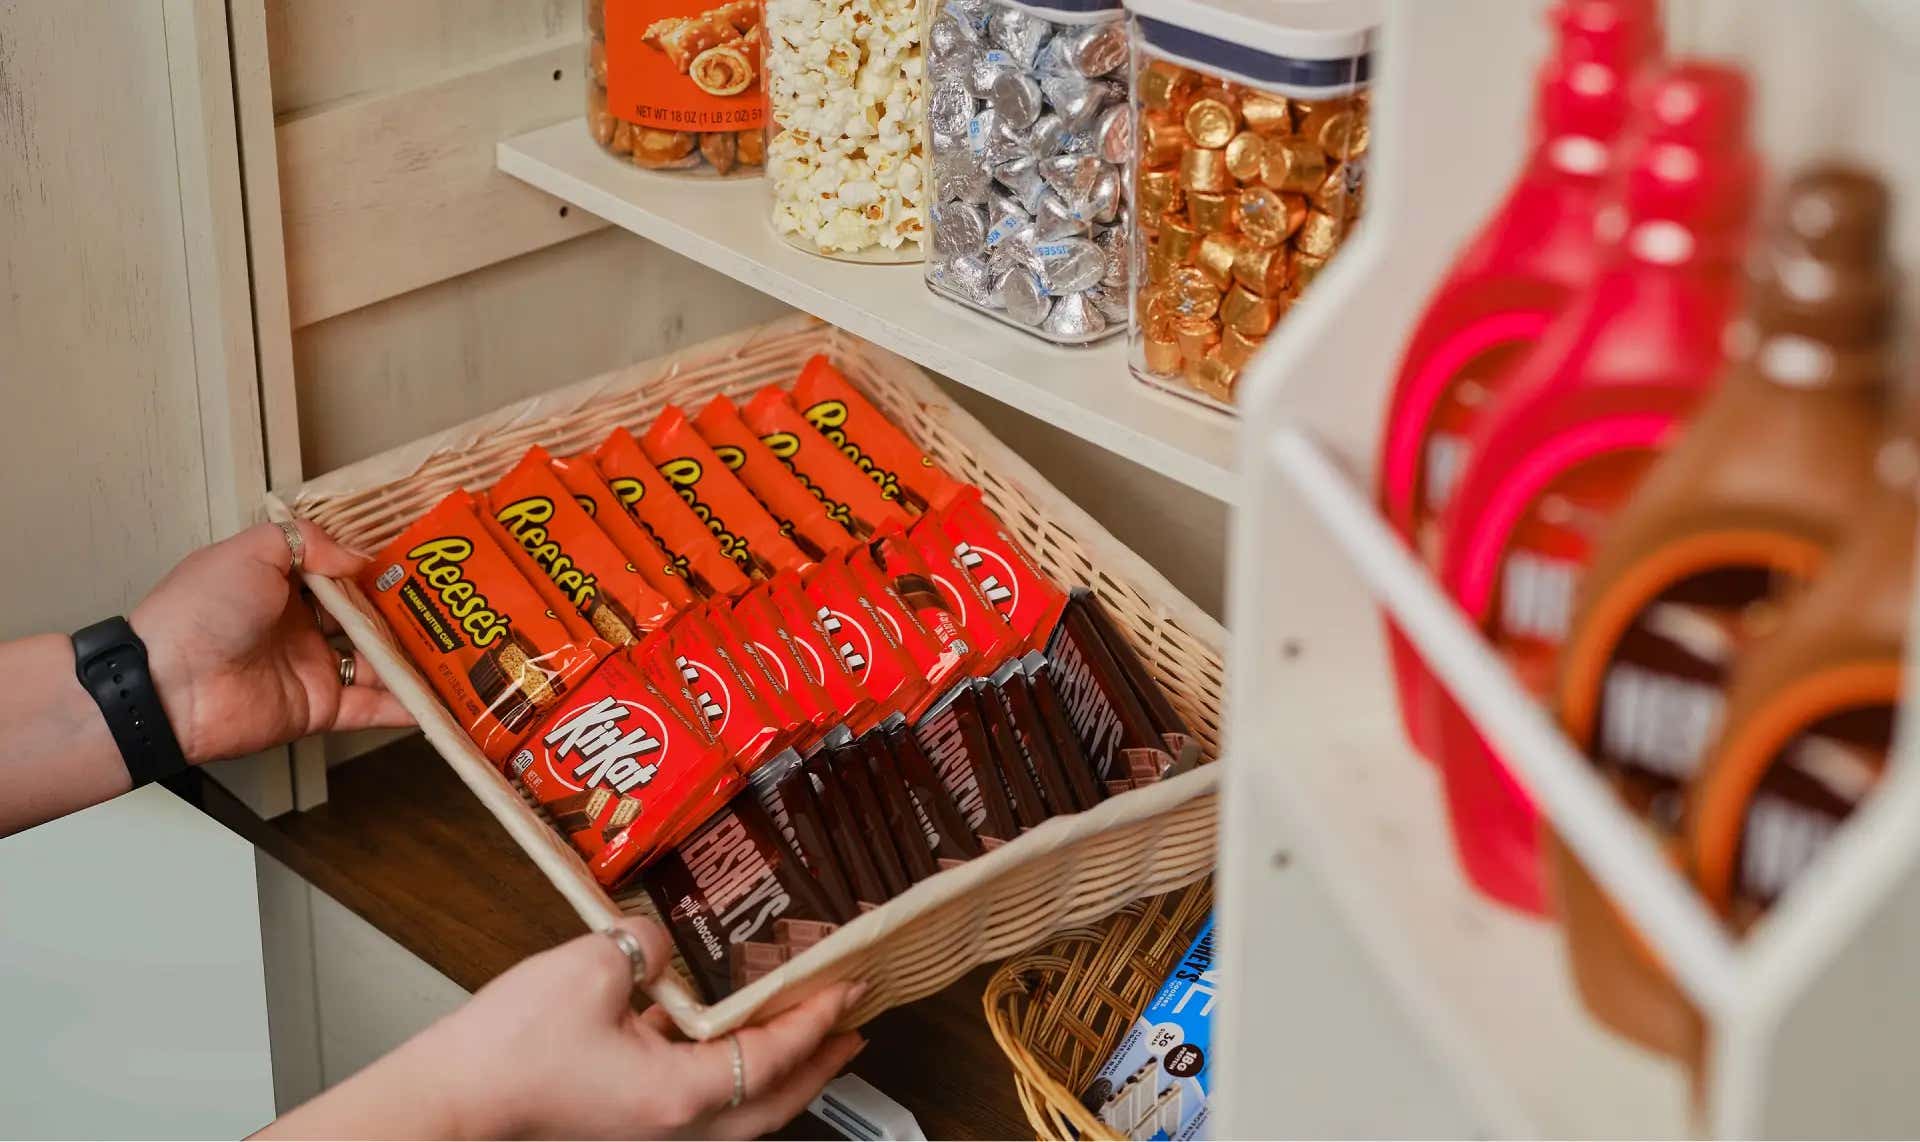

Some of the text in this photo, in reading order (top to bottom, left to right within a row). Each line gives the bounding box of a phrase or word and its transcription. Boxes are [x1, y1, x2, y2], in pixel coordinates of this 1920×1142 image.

[636, 104, 652, 119] NET
[655, 107, 668, 121] WT
[671, 110, 682, 122] 18
[684, 110, 697, 124] OZ
[725, 110, 732, 123] 2
[405, 535, 509, 648] Reese's
[406, 588, 427, 614] PEANUT
[422, 610, 444, 636] BUTTER
[438, 631, 456, 651] CUPS
[516, 752, 532, 769] 210
[679, 894, 725, 961] milk chocolate
[1159, 1033, 1175, 1048] 3G
[1169, 1047, 1187, 1070] PROTEIN
[1176, 1051, 1198, 1073] 18G
